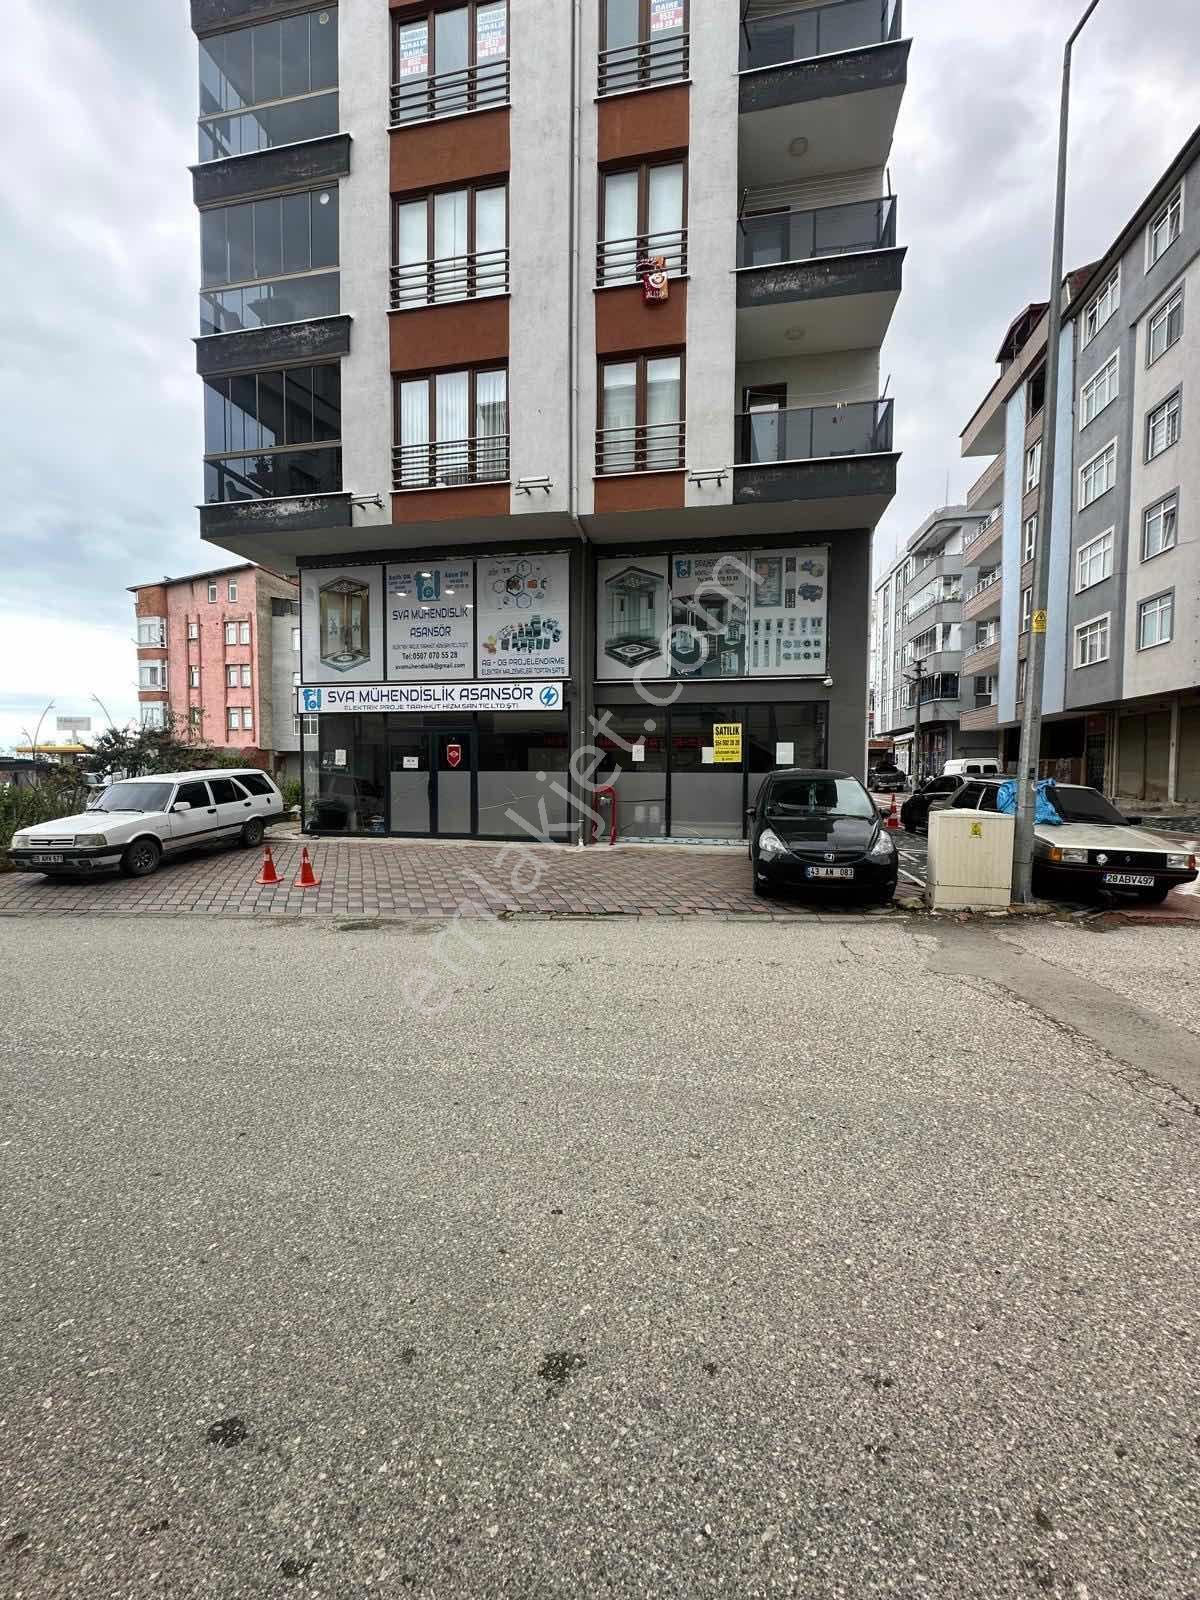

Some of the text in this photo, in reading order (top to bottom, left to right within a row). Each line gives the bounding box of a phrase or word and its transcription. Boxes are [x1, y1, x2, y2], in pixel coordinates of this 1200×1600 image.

[392, 609, 410, 621] SVA
[327, 683, 534, 703] SVA MÜHENDİSLİK ASANSÖR
[715, 726, 740, 736] SATILIK
